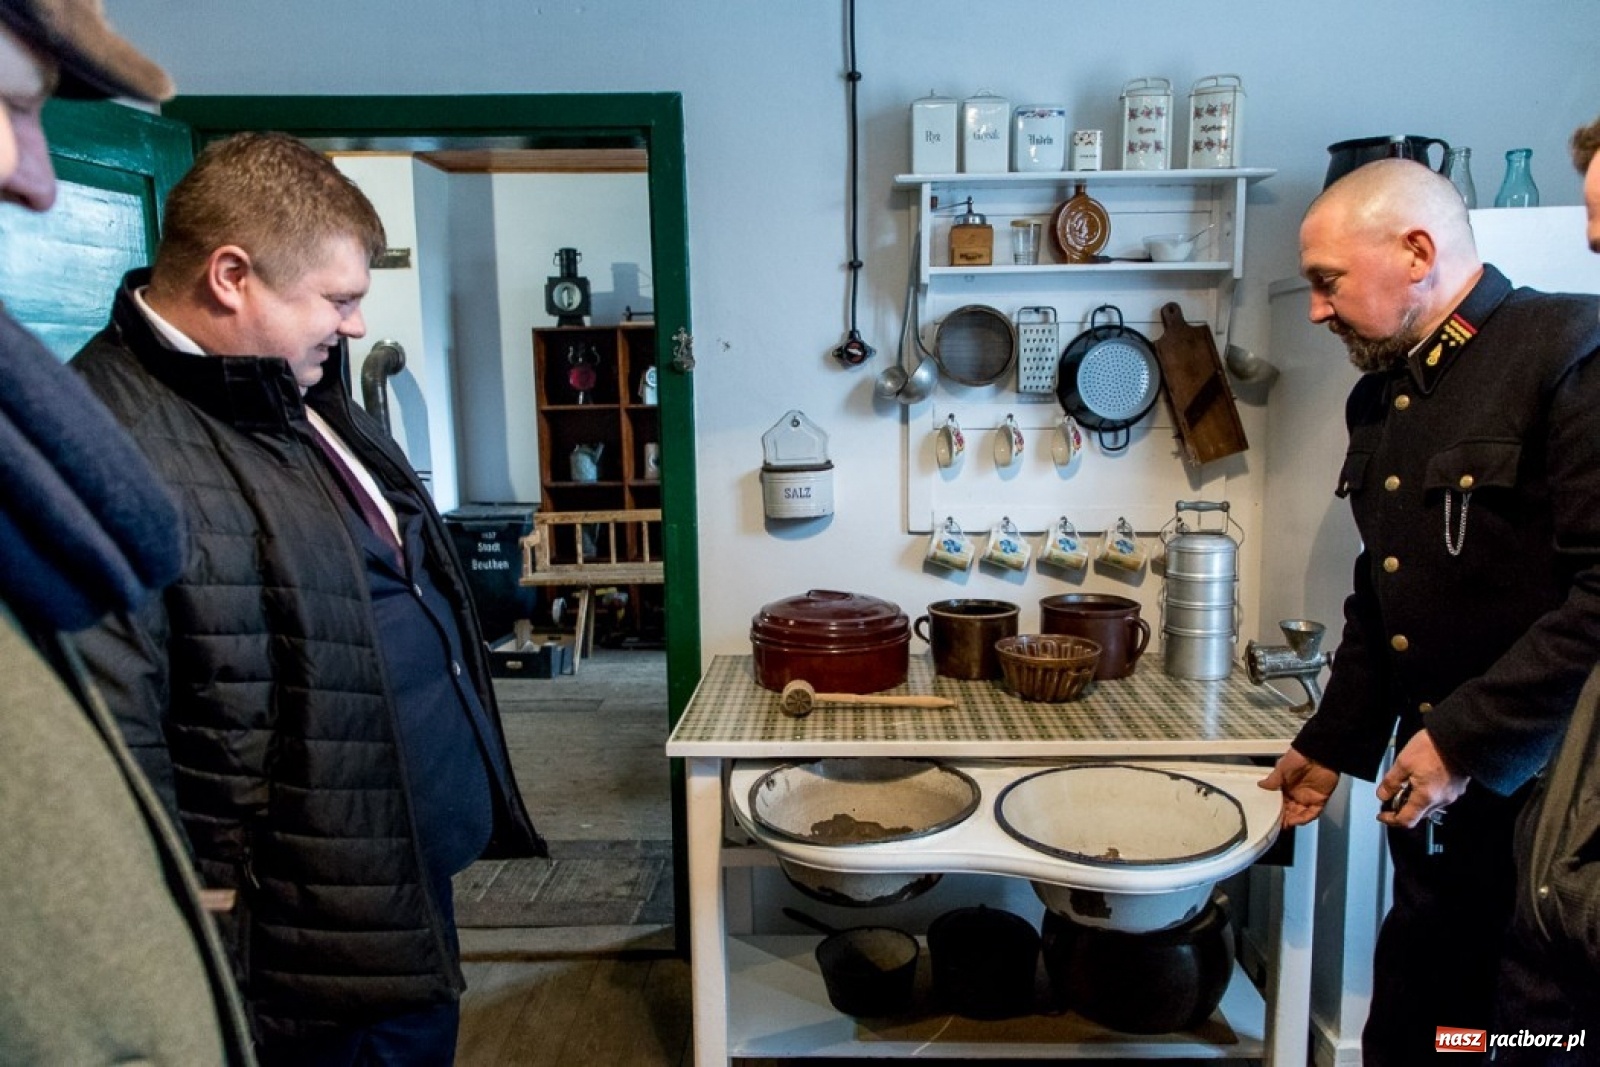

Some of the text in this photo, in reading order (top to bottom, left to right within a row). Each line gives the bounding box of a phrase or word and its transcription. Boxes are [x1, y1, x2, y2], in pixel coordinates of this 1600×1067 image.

[784, 486, 812, 499] SALZ
[477, 542, 501, 553] Stadt
[471, 558, 510, 571] Beuthen
